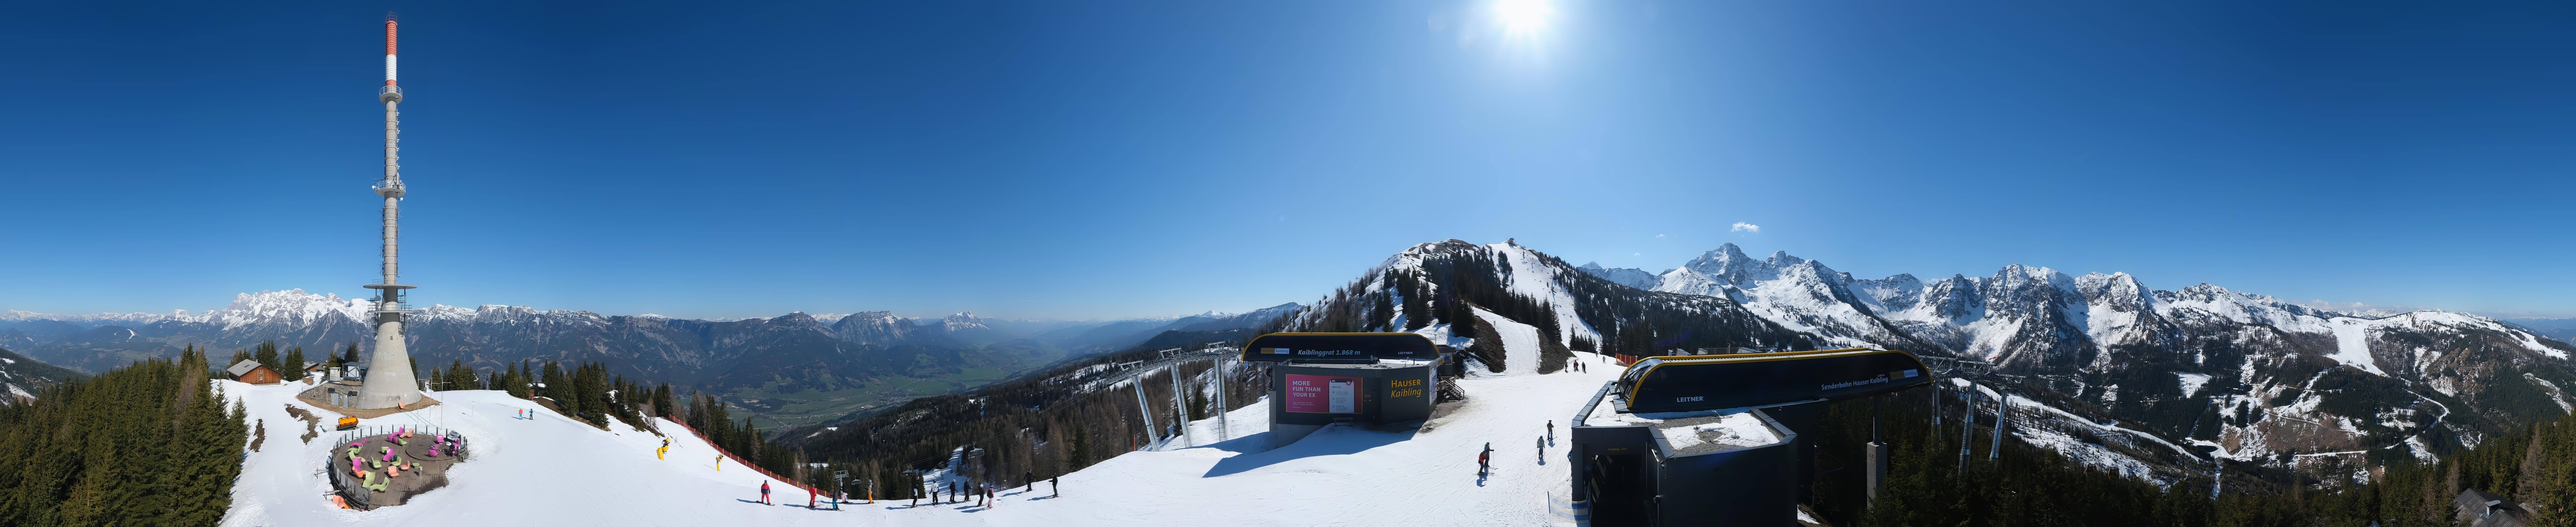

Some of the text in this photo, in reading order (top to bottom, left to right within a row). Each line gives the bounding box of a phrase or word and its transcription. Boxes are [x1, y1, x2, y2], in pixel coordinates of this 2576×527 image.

[1391, 379, 1421, 388] HAUSER
[1821, 381, 1852, 390] Senderbahn
[1391, 388, 1421, 398] Kaibling
